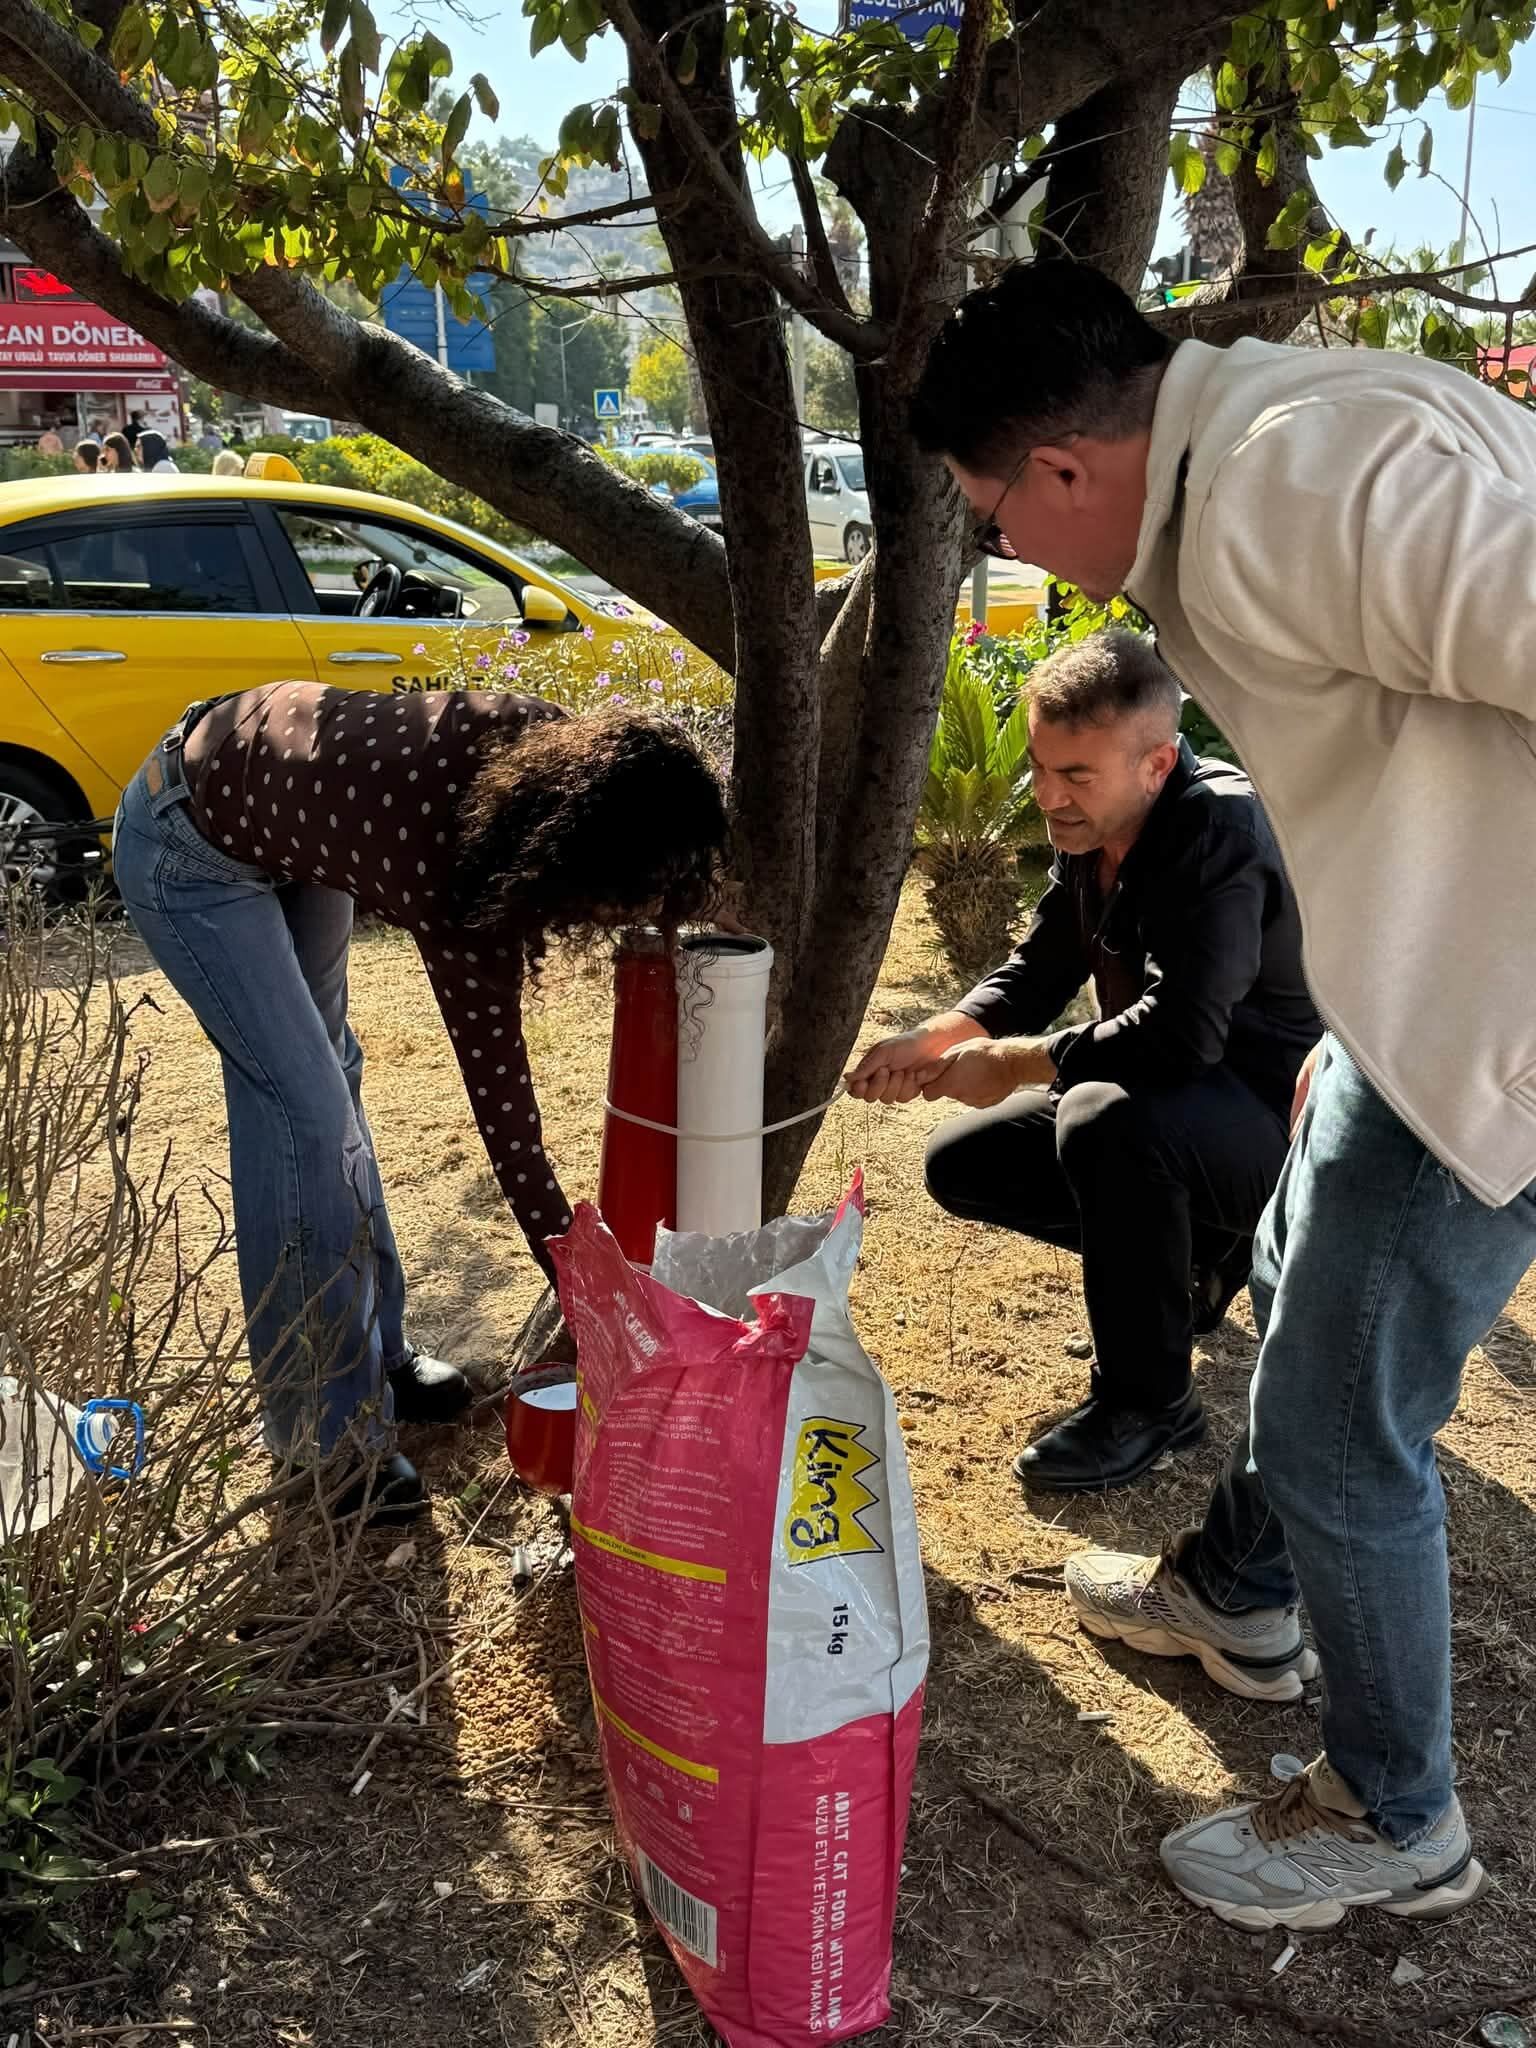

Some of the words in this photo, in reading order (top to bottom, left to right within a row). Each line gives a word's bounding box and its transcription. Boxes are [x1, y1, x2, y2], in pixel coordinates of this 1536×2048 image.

[52, 320, 146, 347] DÖNER
[48, 351, 77, 363] TAVUK
[77, 349, 107, 363] DÖNER
[789, 1429, 849, 1550] King
[832, 1603, 849, 1628] 15
[827, 1632, 849, 1655] kg
[815, 1794, 829, 1835] KUZU
[834, 1791, 850, 1841] ADULT
[814, 1839, 830, 1871] ETLİ
[832, 1850, 849, 1880] CAT
[811, 1872, 829, 1940] YETİŞKİN
[830, 1889, 847, 1932] FOOD
[810, 1942, 826, 1977] KEDİ
[829, 1937, 844, 1981] WITH
[808, 1979, 825, 2035] MAMASI
[827, 1985, 843, 2030] LAMB
